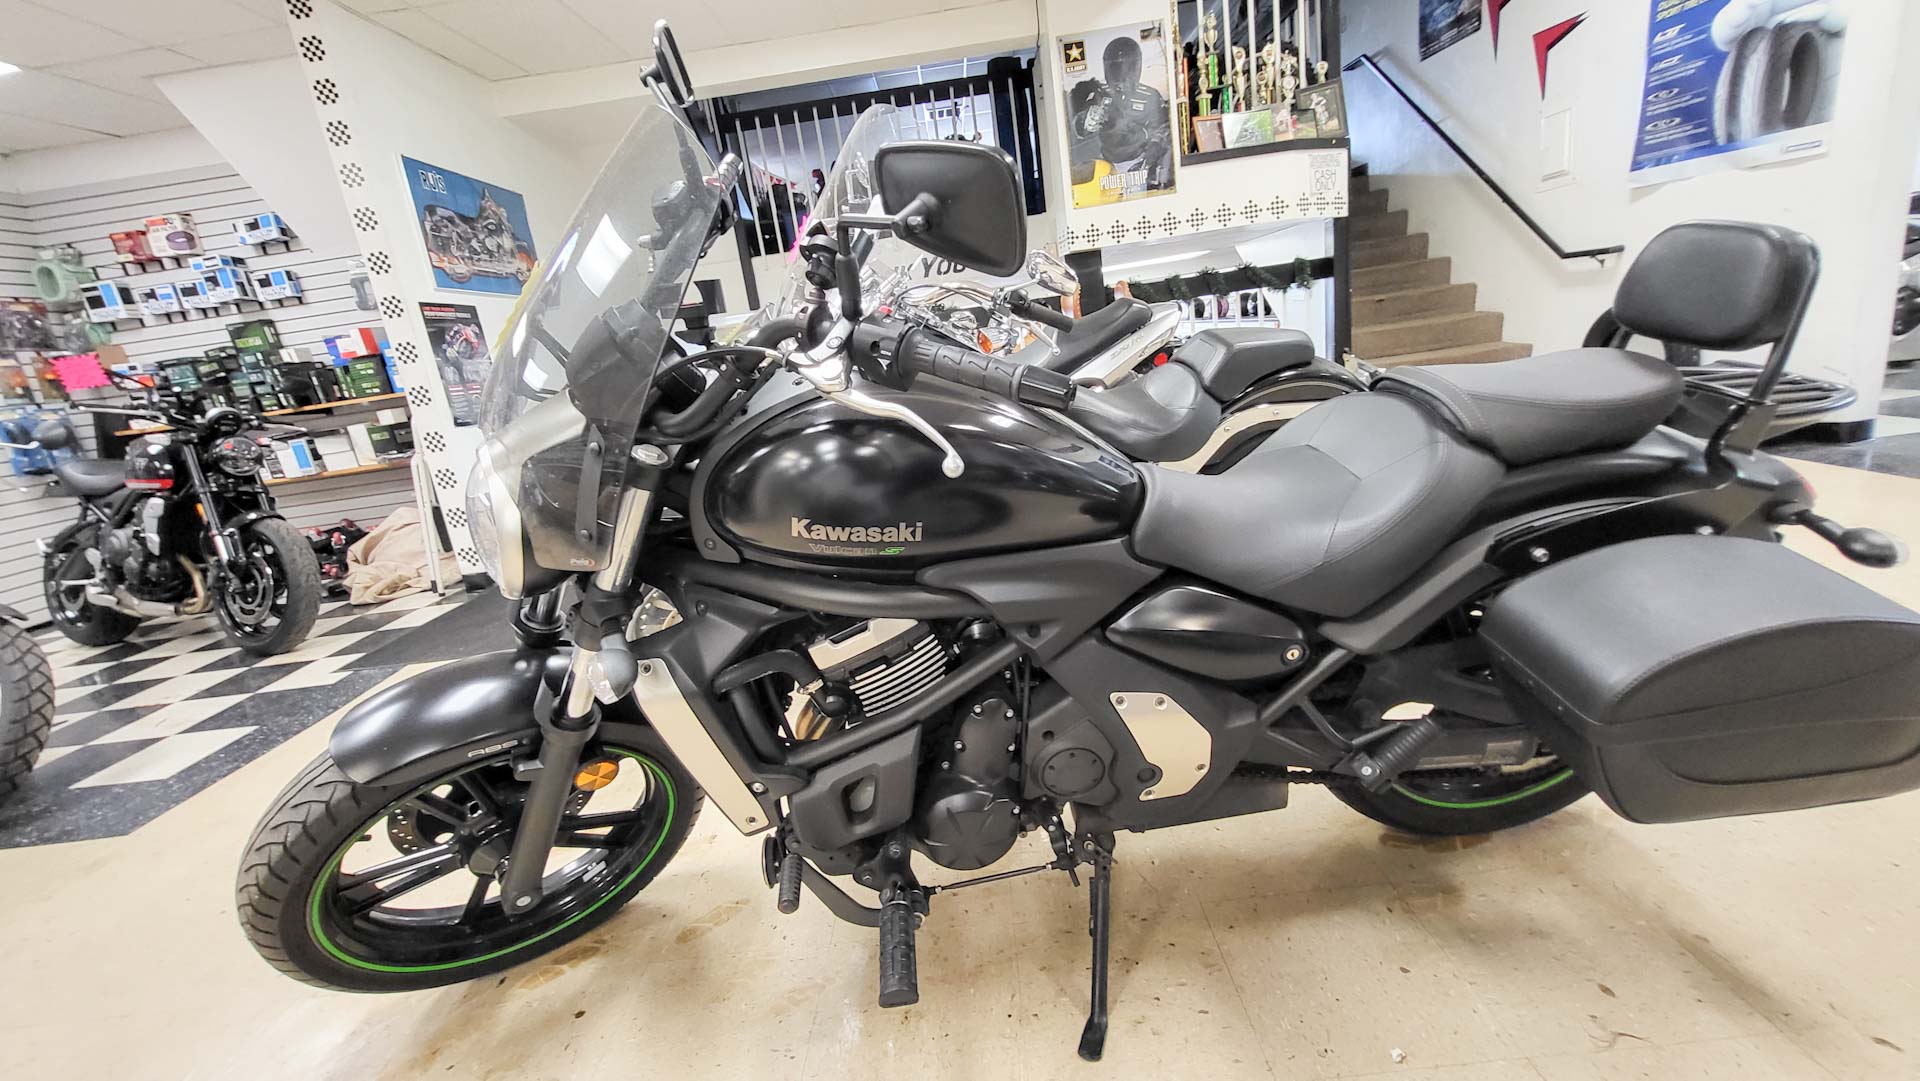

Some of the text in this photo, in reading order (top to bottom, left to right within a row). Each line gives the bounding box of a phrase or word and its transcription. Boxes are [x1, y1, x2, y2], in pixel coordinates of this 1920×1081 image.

[1100, 173, 1128, 191] POWER
[1129, 170, 1148, 186] TRIP
[791, 516, 923, 543] Kawasaki
[809, 543, 905, 556] Vulcan S
[467, 739, 519, 758] ABS
